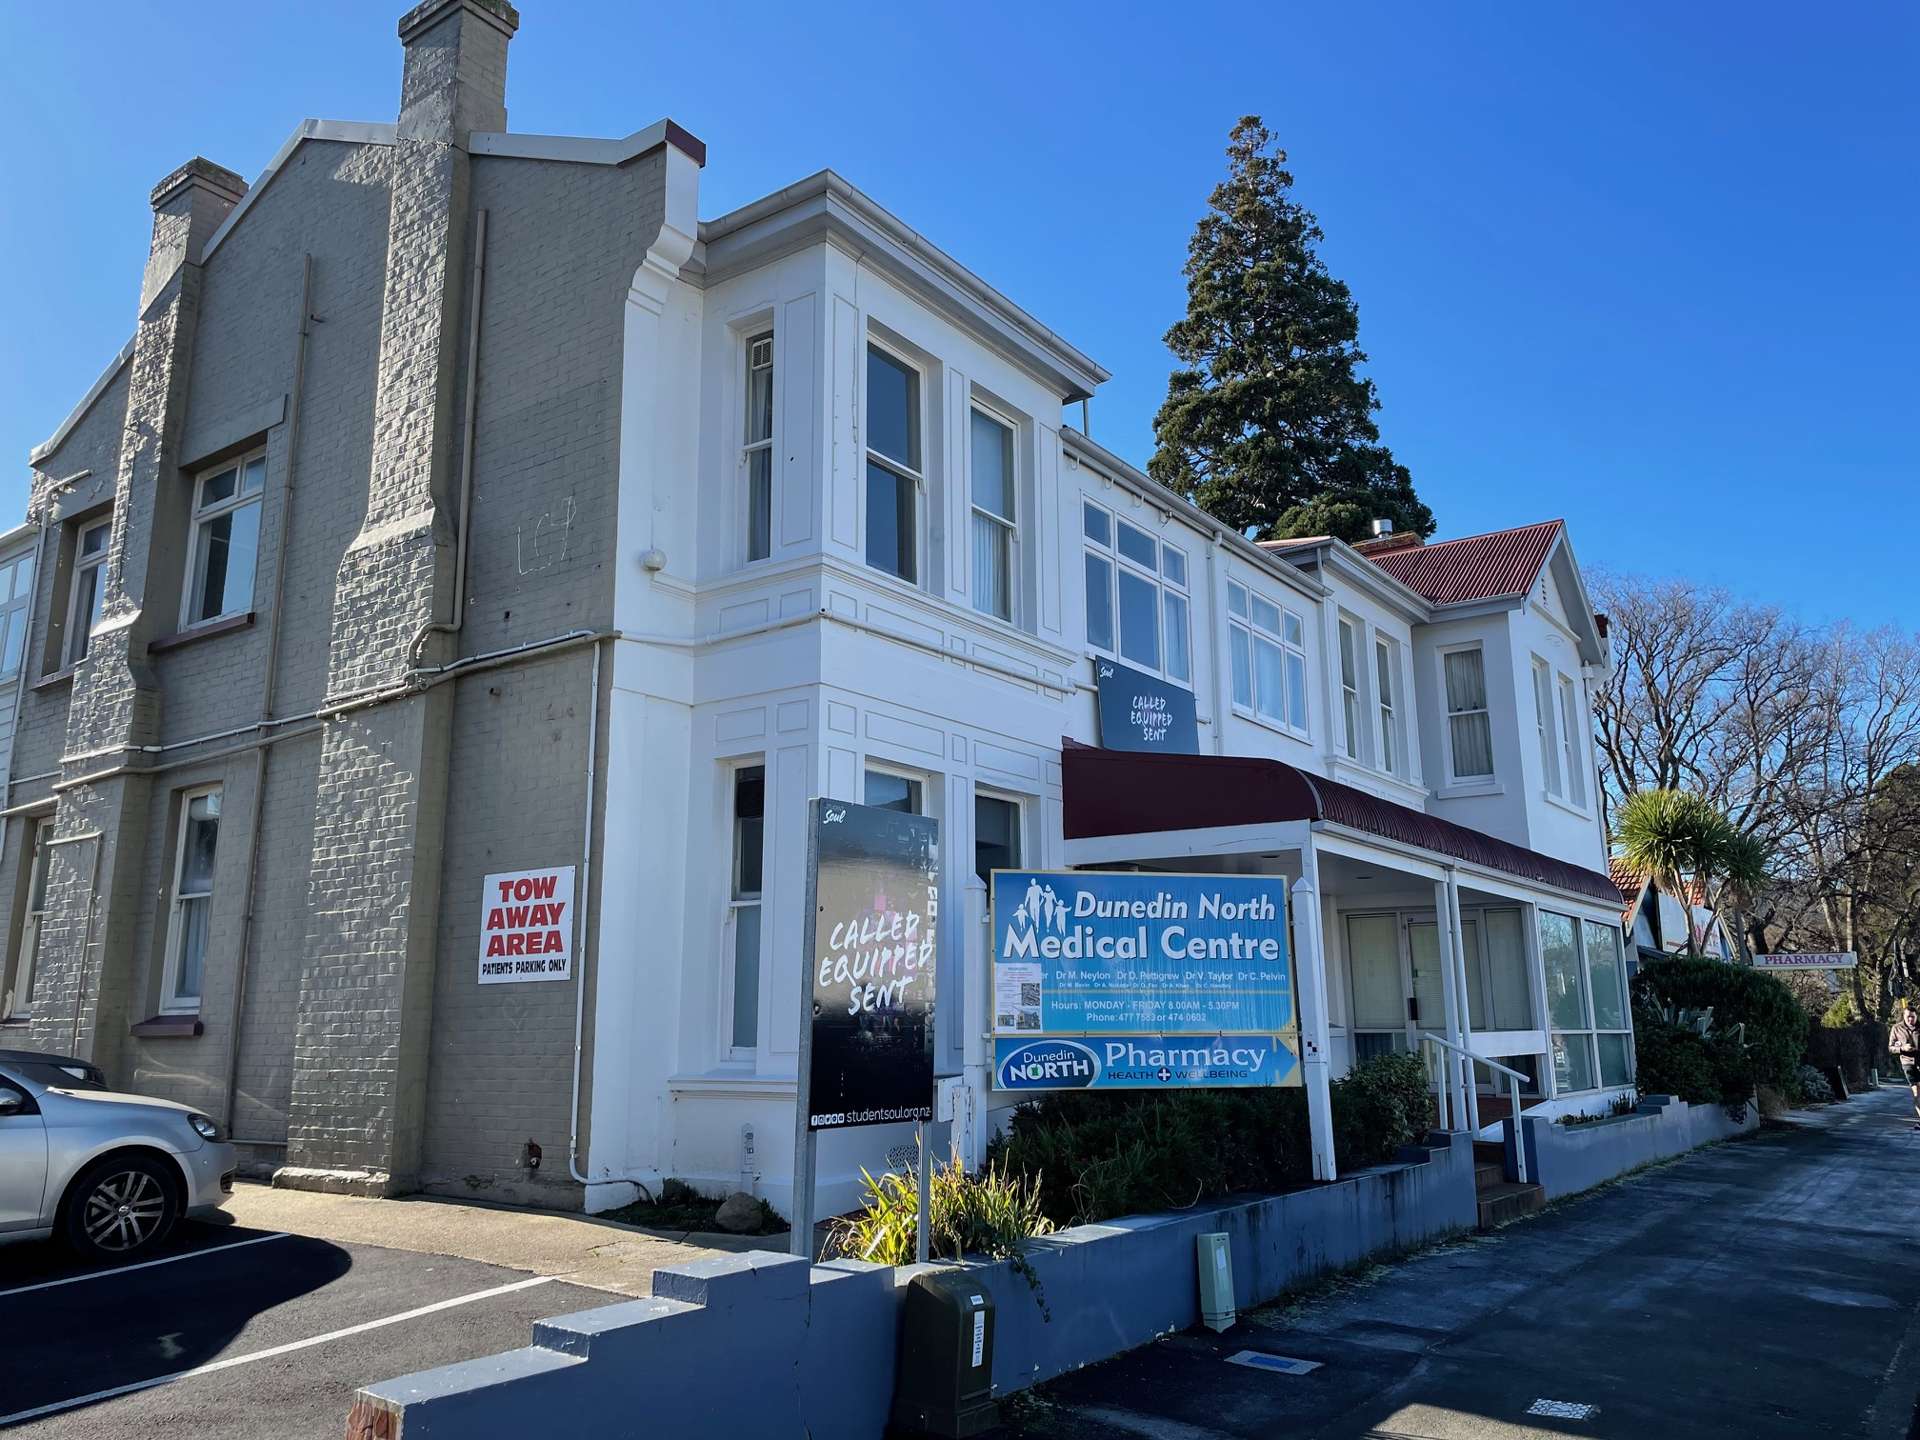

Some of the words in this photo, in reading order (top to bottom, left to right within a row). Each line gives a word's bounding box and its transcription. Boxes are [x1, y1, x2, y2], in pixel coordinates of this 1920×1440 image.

[1132, 696, 1166, 711] CALLED
[1131, 710, 1173, 728] EQUIPPED
[1143, 728, 1168, 742] SENT
[823, 810, 846, 824] Soul
[499, 876, 557, 903] TOW
[1074, 891, 1188, 919] Dunedin
[1199, 893, 1276, 921] North
[486, 902, 565, 930] AWAY
[829, 910, 920, 951] CALLED
[486, 930, 563, 957] AREA
[1003, 923, 1148, 960] Medical
[1161, 926, 1280, 961] Centre
[482, 961, 513, 975] PATIENTS
[515, 960, 546, 974] PARKING
[549, 959, 566, 972] ONLY
[819, 938, 933, 987] EQUIPPED
[1764, 954, 1844, 965] PHARMACY
[1056, 970, 1066, 980] Dr
[1080, 970, 1111, 982] Neylon
[1117, 971, 1127, 980] Dr
[1185, 972, 1195, 980] Dr
[1207, 972, 1233, 983] Taylor
[1238, 972, 1248, 981] Dr
[848, 975, 914, 1017] SENT
[1084, 1000, 1125, 1010] MONDAY
[1132, 1000, 1166, 1010] FRIDAY
[1023, 1049, 1075, 1064] Dunedin
[1105, 1042, 1266, 1072] Pharmacy
[1010, 1060, 1090, 1082] NORTH
[1107, 1070, 1154, 1080] HEALTH
[1175, 1070, 1248, 1080] WELLBEING
[846, 1106, 931, 1123] studentsoul.org.nz
